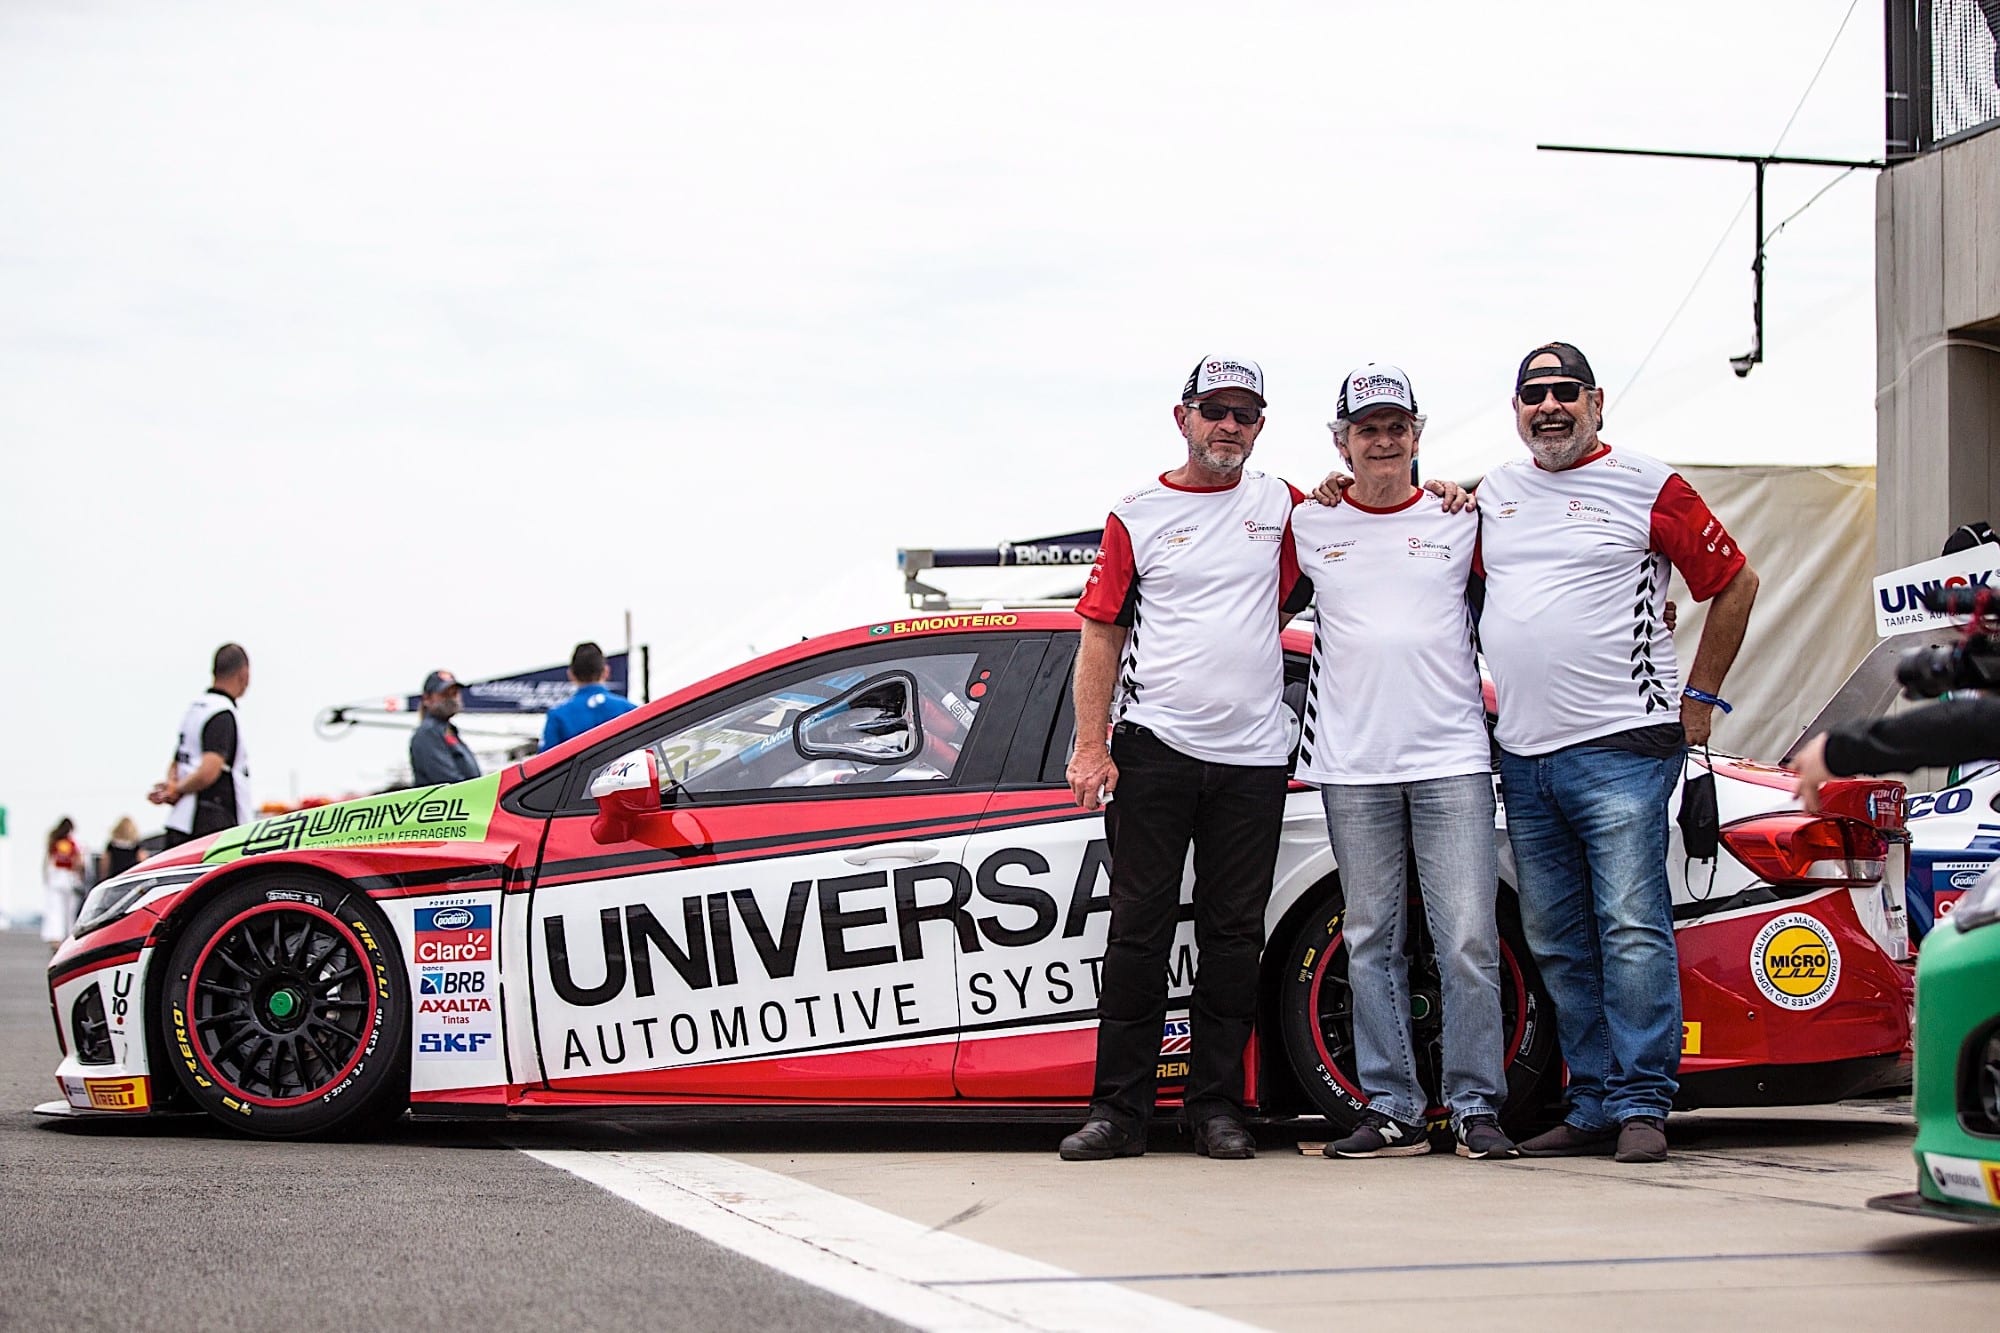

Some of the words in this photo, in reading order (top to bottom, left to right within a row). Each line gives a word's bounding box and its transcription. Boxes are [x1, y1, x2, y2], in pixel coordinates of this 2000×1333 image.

[1223, 364, 1257, 382] UNIVERSAL
[1368, 377, 1405, 391] UNIVERSAL
[893, 614, 1018, 634] B.MONTEIRO
[1885, 613, 1924, 627] TAMPAS
[398, 826, 468, 842] FERRAGENS
[544, 838, 1195, 1006] UNIVERSA
[1754, 919, 1786, 958] PALHETAS
[352, 921, 390, 999] PIRLLI
[419, 939, 480, 961] Claro
[1771, 955, 1825, 968] MICRO
[114, 970, 134, 998] U
[444, 971, 485, 994] BRB
[1755, 968, 1774, 996] VIDRO
[1792, 958, 1838, 1007] COMPONENTES
[112, 997, 128, 1016] 10
[419, 998, 492, 1013] AXALTA
[1775, 993, 1789, 1004] DO
[442, 1016, 470, 1024] Tintas
[564, 983, 920, 1070] AUTOMOTIVE
[419, 1033, 492, 1053] SKF
[90, 1083, 136, 1106] PIRELLI
